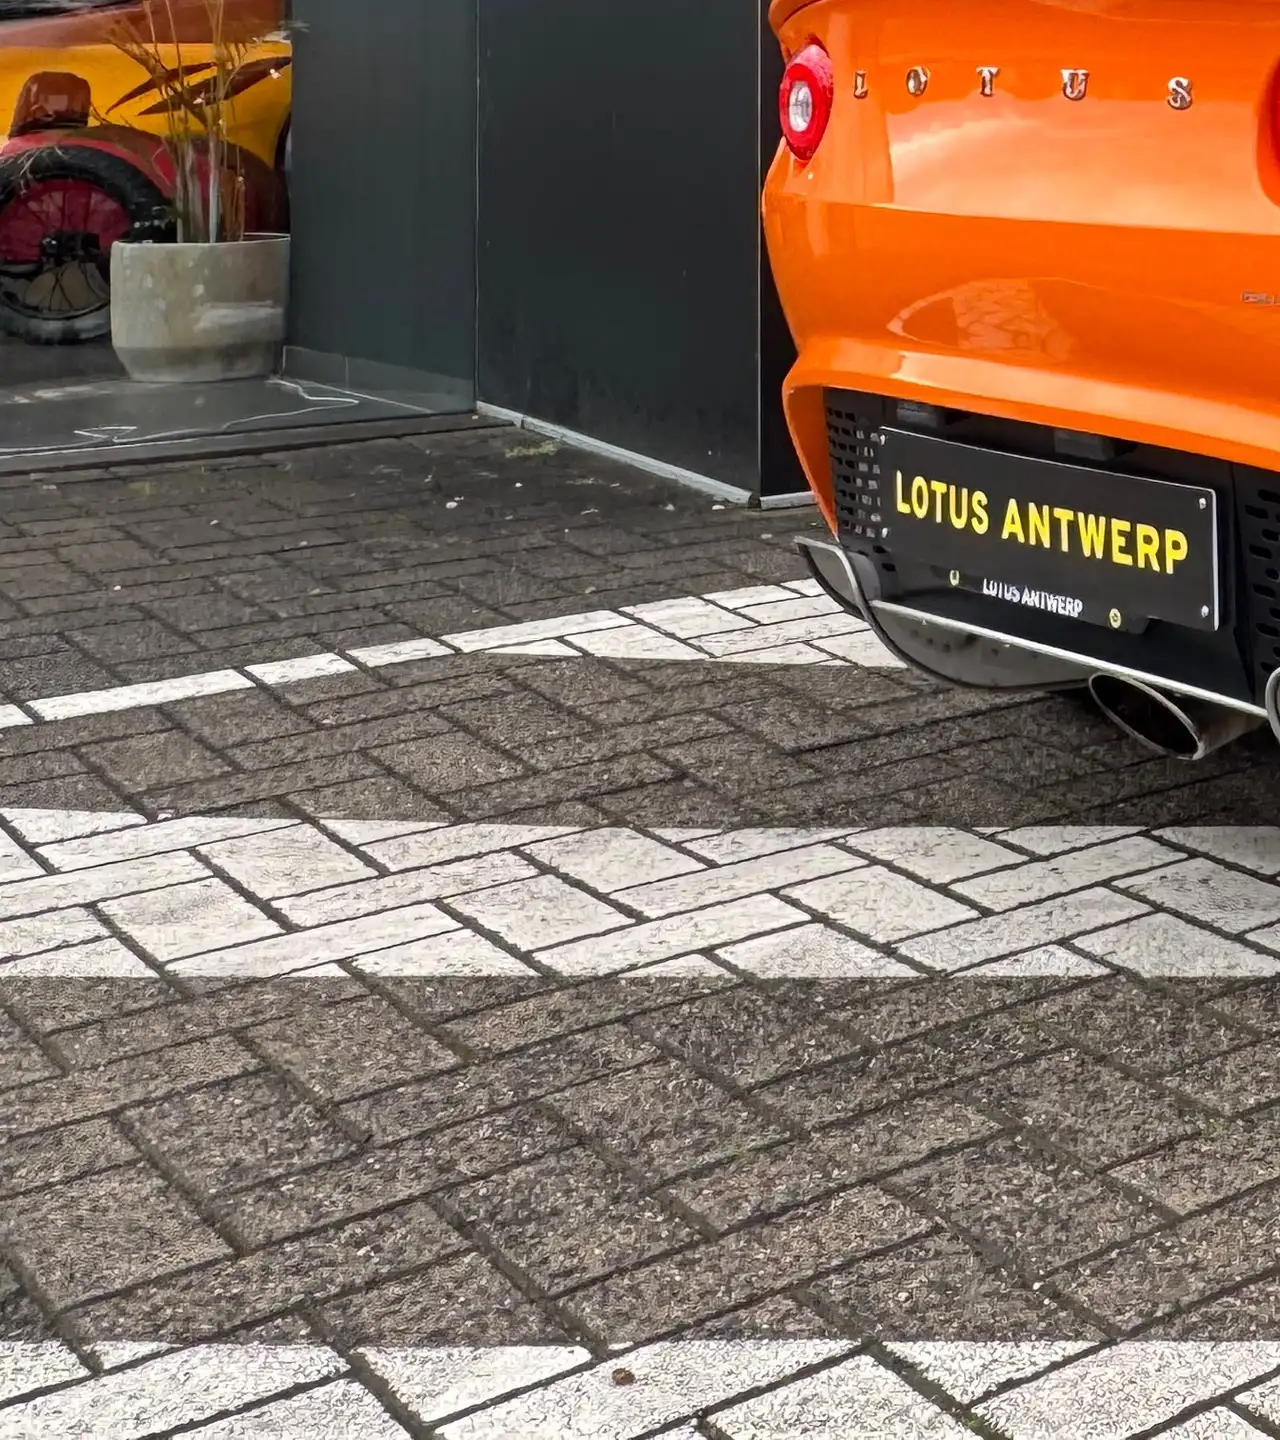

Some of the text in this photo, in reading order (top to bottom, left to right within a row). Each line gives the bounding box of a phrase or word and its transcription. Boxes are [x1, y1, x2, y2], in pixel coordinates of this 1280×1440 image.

[853, 65, 1193, 111] LOTUS
[895, 470, 1189, 576] LOTUS ANTWERP
[983, 577, 1084, 619] LOTUS ANTWERP
